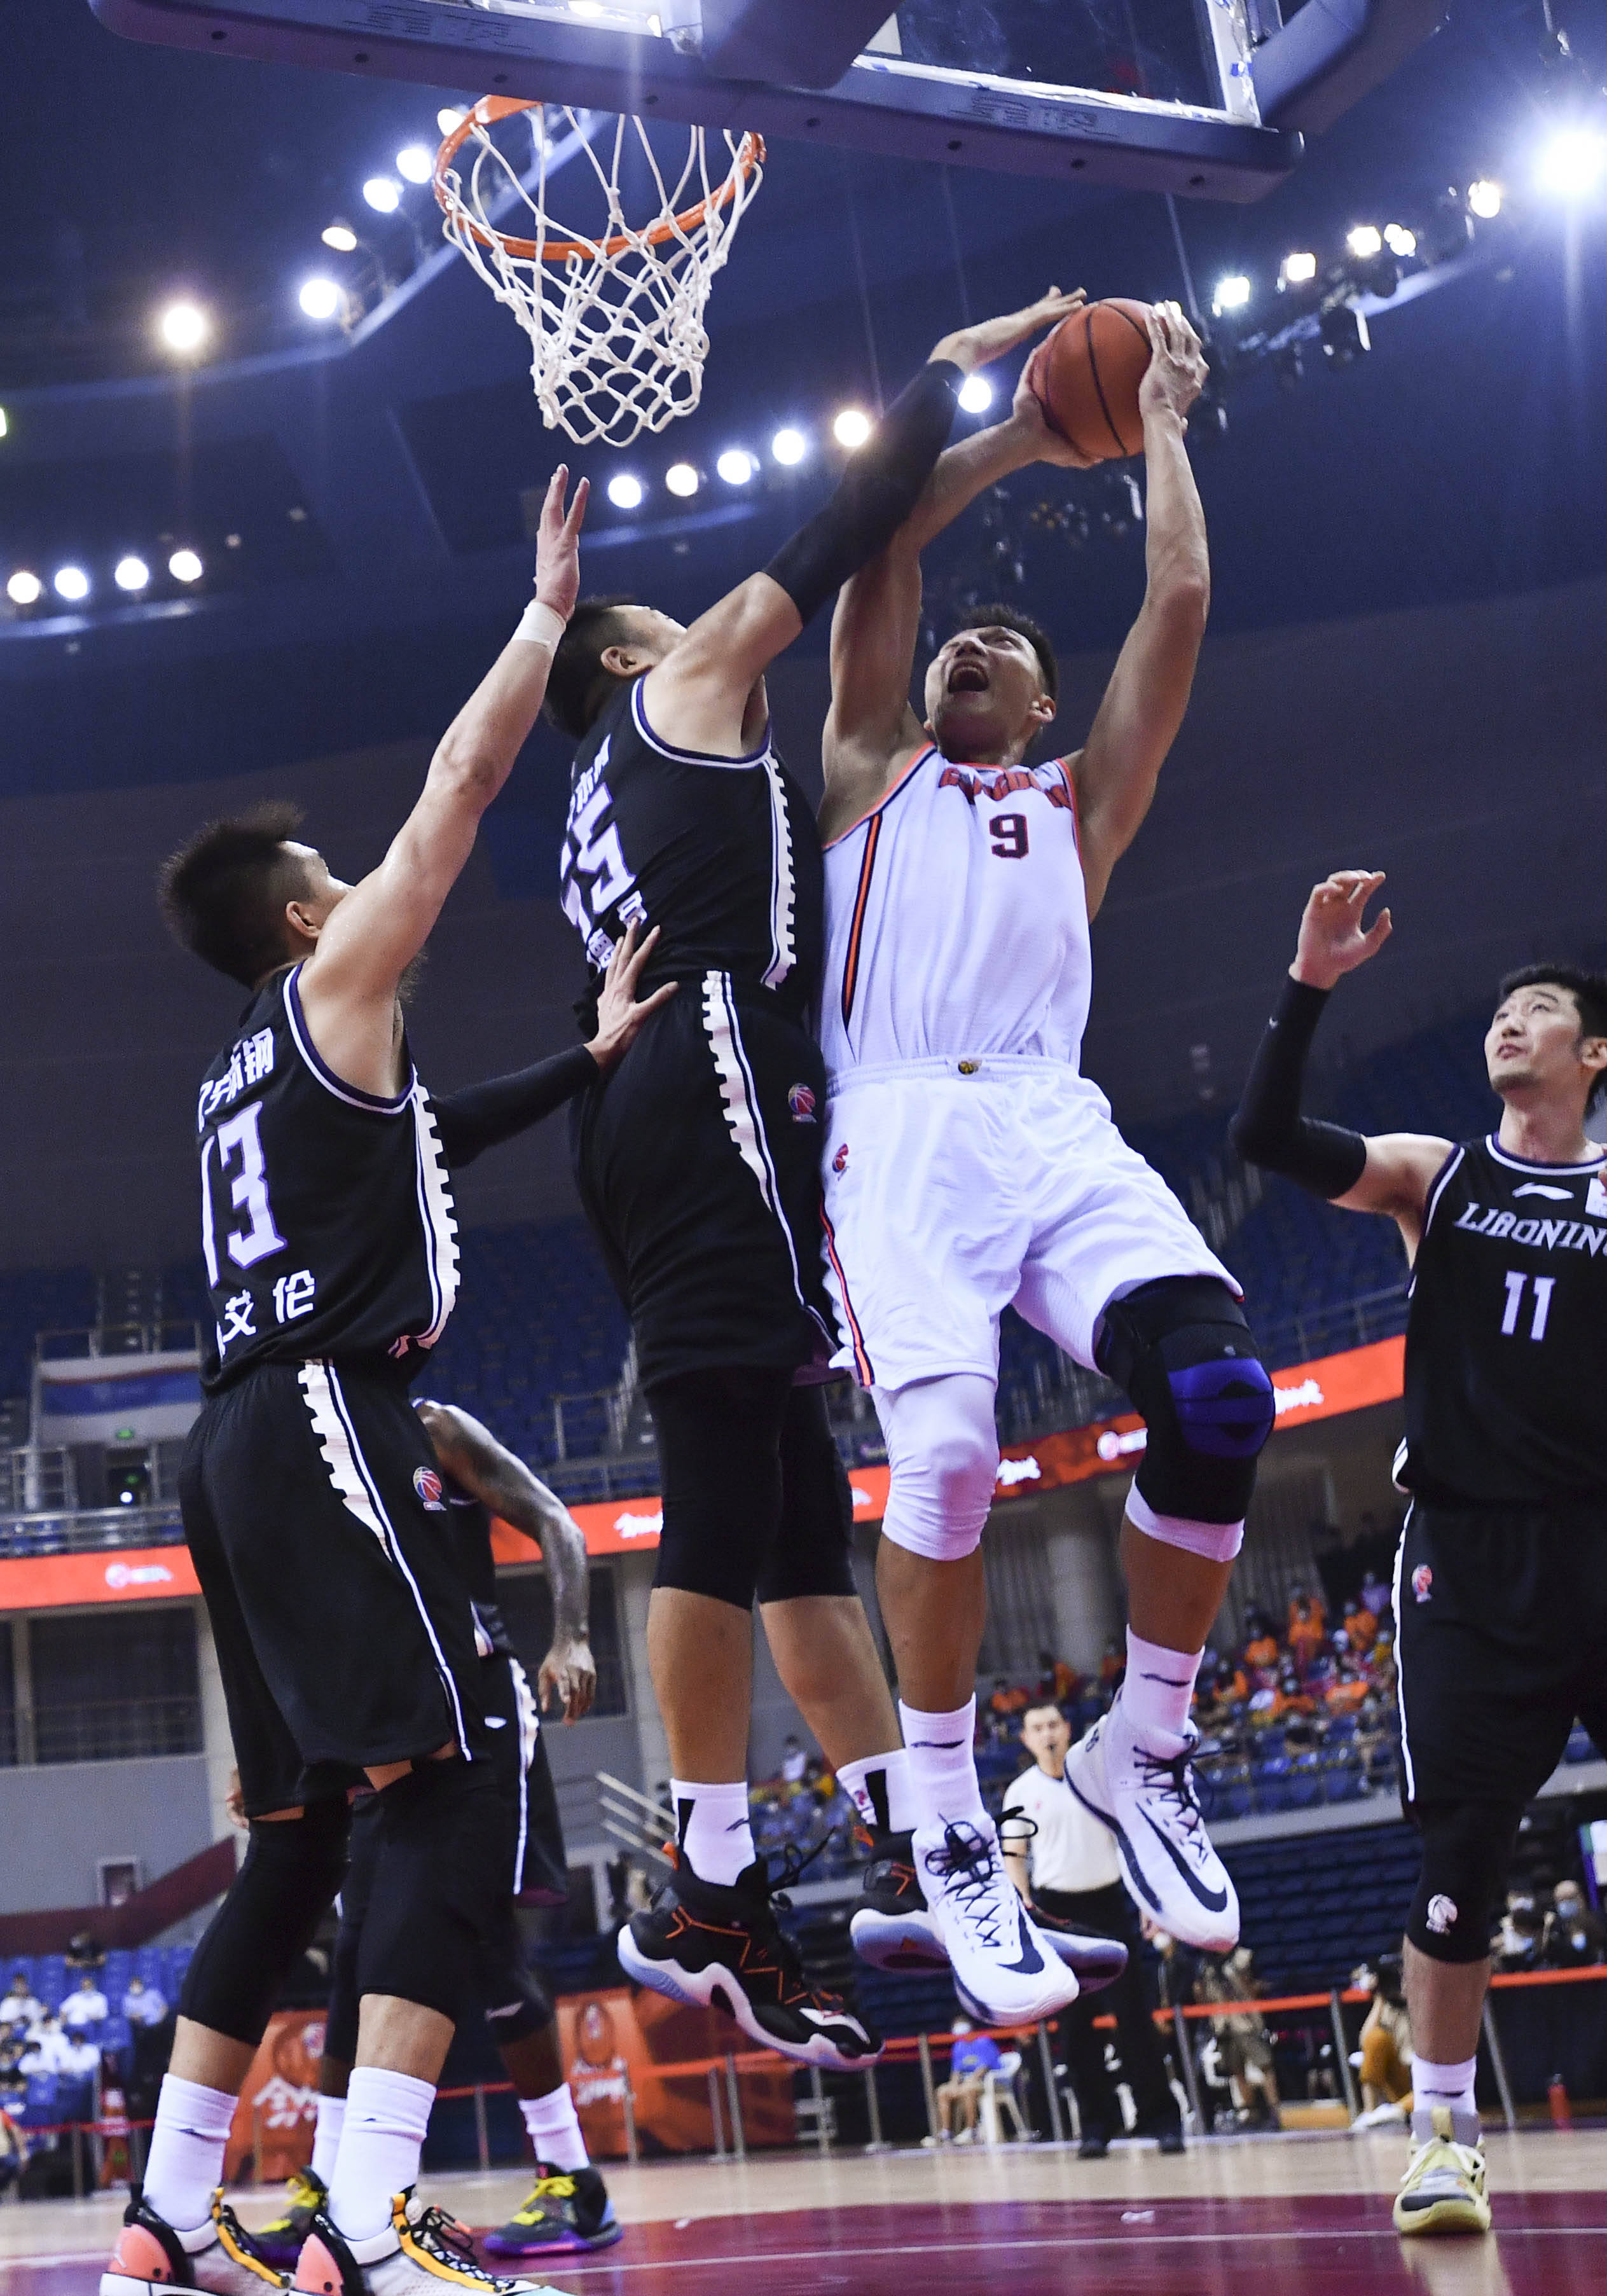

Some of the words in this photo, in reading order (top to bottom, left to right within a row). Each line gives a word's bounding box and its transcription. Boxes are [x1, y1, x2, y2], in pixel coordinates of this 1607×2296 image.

[989, 813, 1029, 860] 9
[200, 1100, 287, 1289] 13
[1454, 1201, 1607, 1258] LIAONIN
[216, 1269, 316, 1359] 艾伦
[1501, 1270, 1557, 1341] 11
